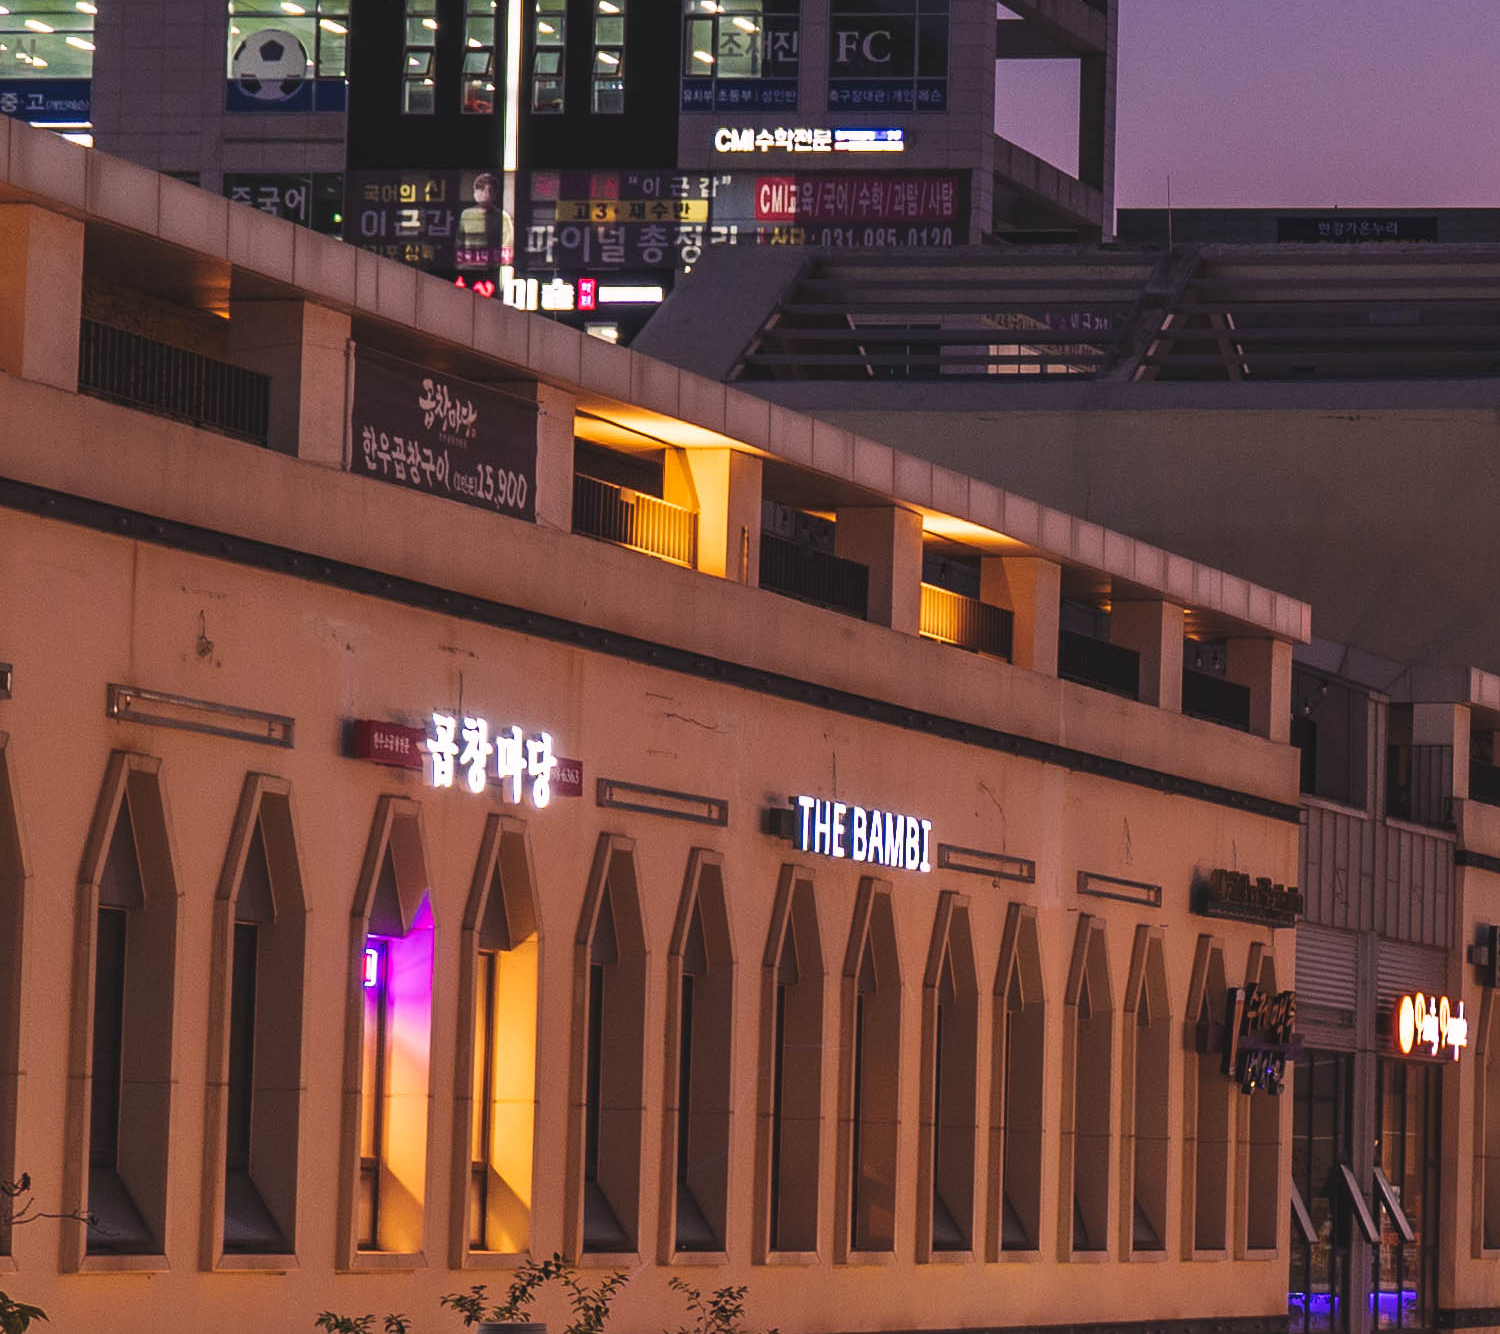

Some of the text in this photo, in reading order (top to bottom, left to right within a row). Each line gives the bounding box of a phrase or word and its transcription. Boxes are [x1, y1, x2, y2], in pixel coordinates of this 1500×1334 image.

[836, 29, 892, 63] FC
[362, 424, 451, 492] 한우곱창구이
[476, 463, 528, 510] 15,900
[426, 712, 557, 809] 곱창마당
[798, 797, 932, 873] THE BAMBI
